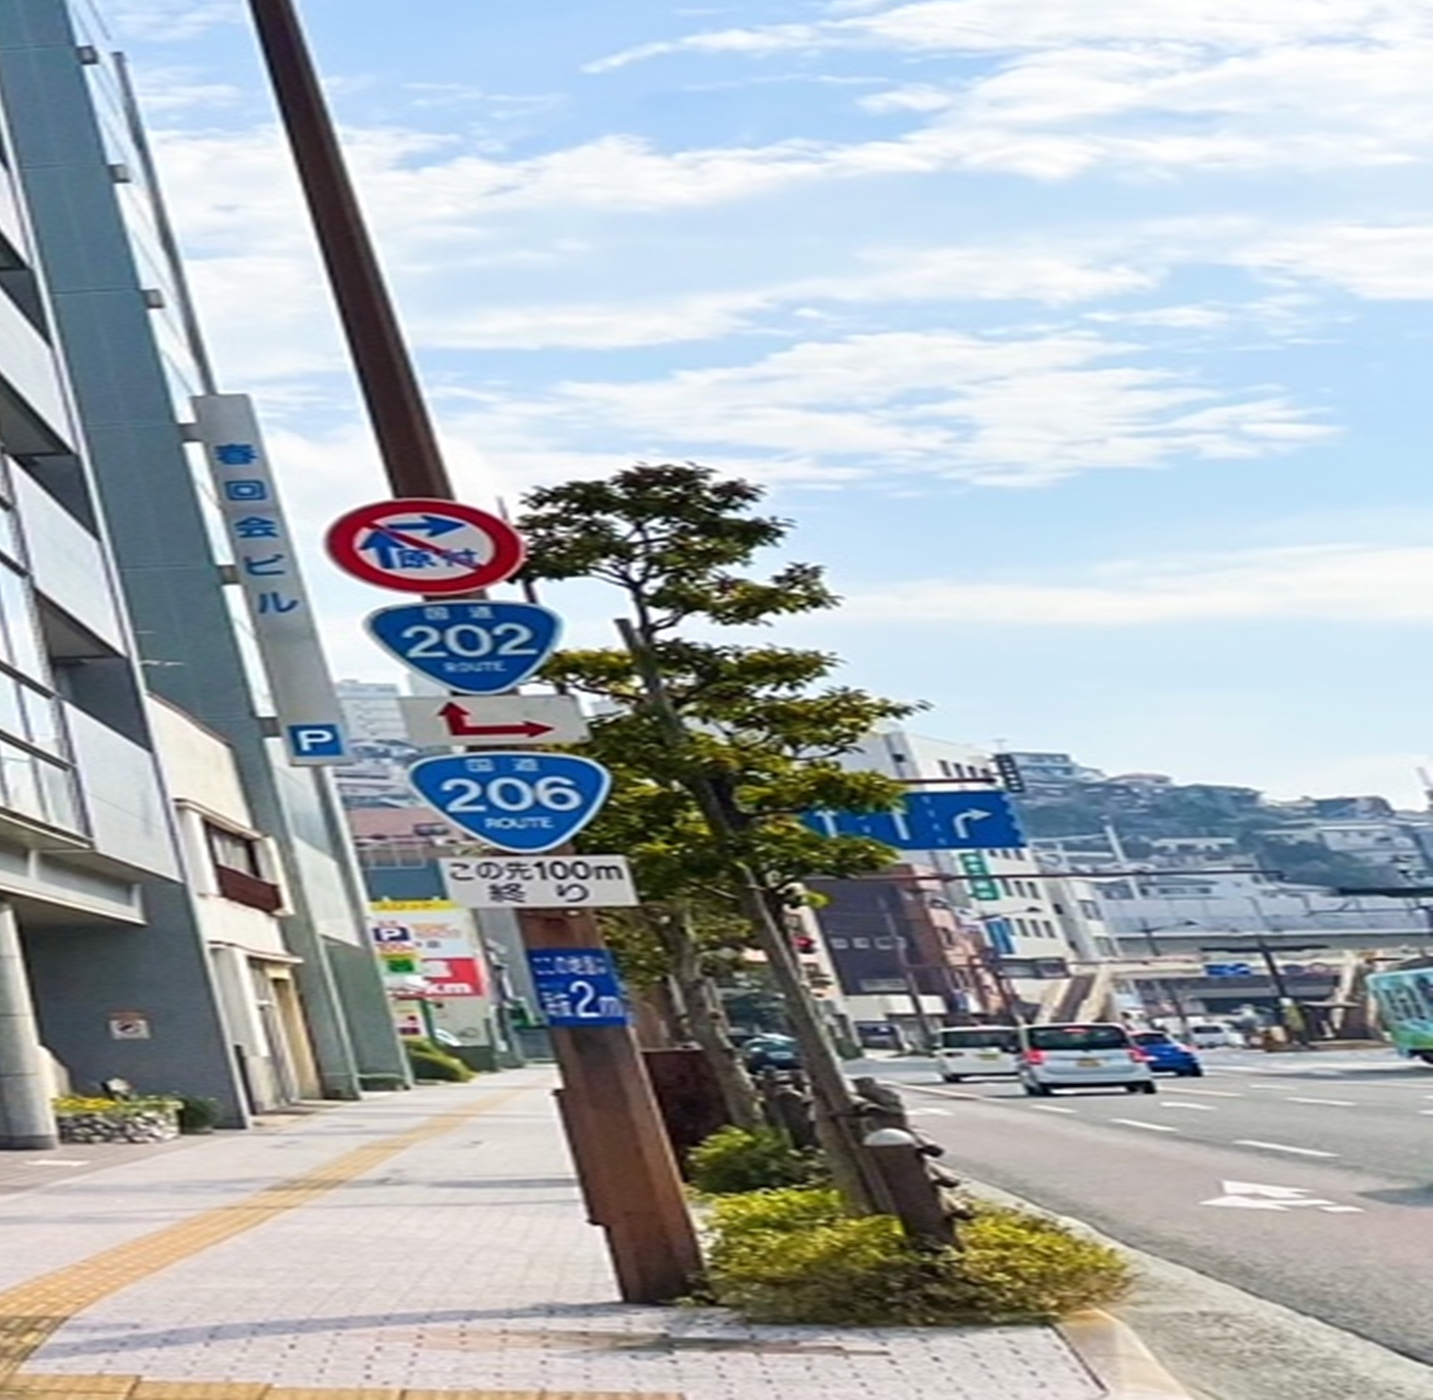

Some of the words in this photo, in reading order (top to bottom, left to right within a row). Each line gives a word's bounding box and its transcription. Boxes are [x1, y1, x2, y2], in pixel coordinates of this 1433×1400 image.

[214, 442, 300, 615] 春回会ビル
[397, 547, 478, 569] 原付
[424, 605, 495, 620] 国道
[401, 622, 538, 658] 202
[444, 660, 508, 674] ROUTE
[299, 728, 333, 752] P
[465, 758, 540, 772] 国道
[440, 775, 582, 813] 206
[484, 816, 555, 829] ROUTE
[489, 883, 589, 902] 終り
[571, 980, 624, 1018] 2m
